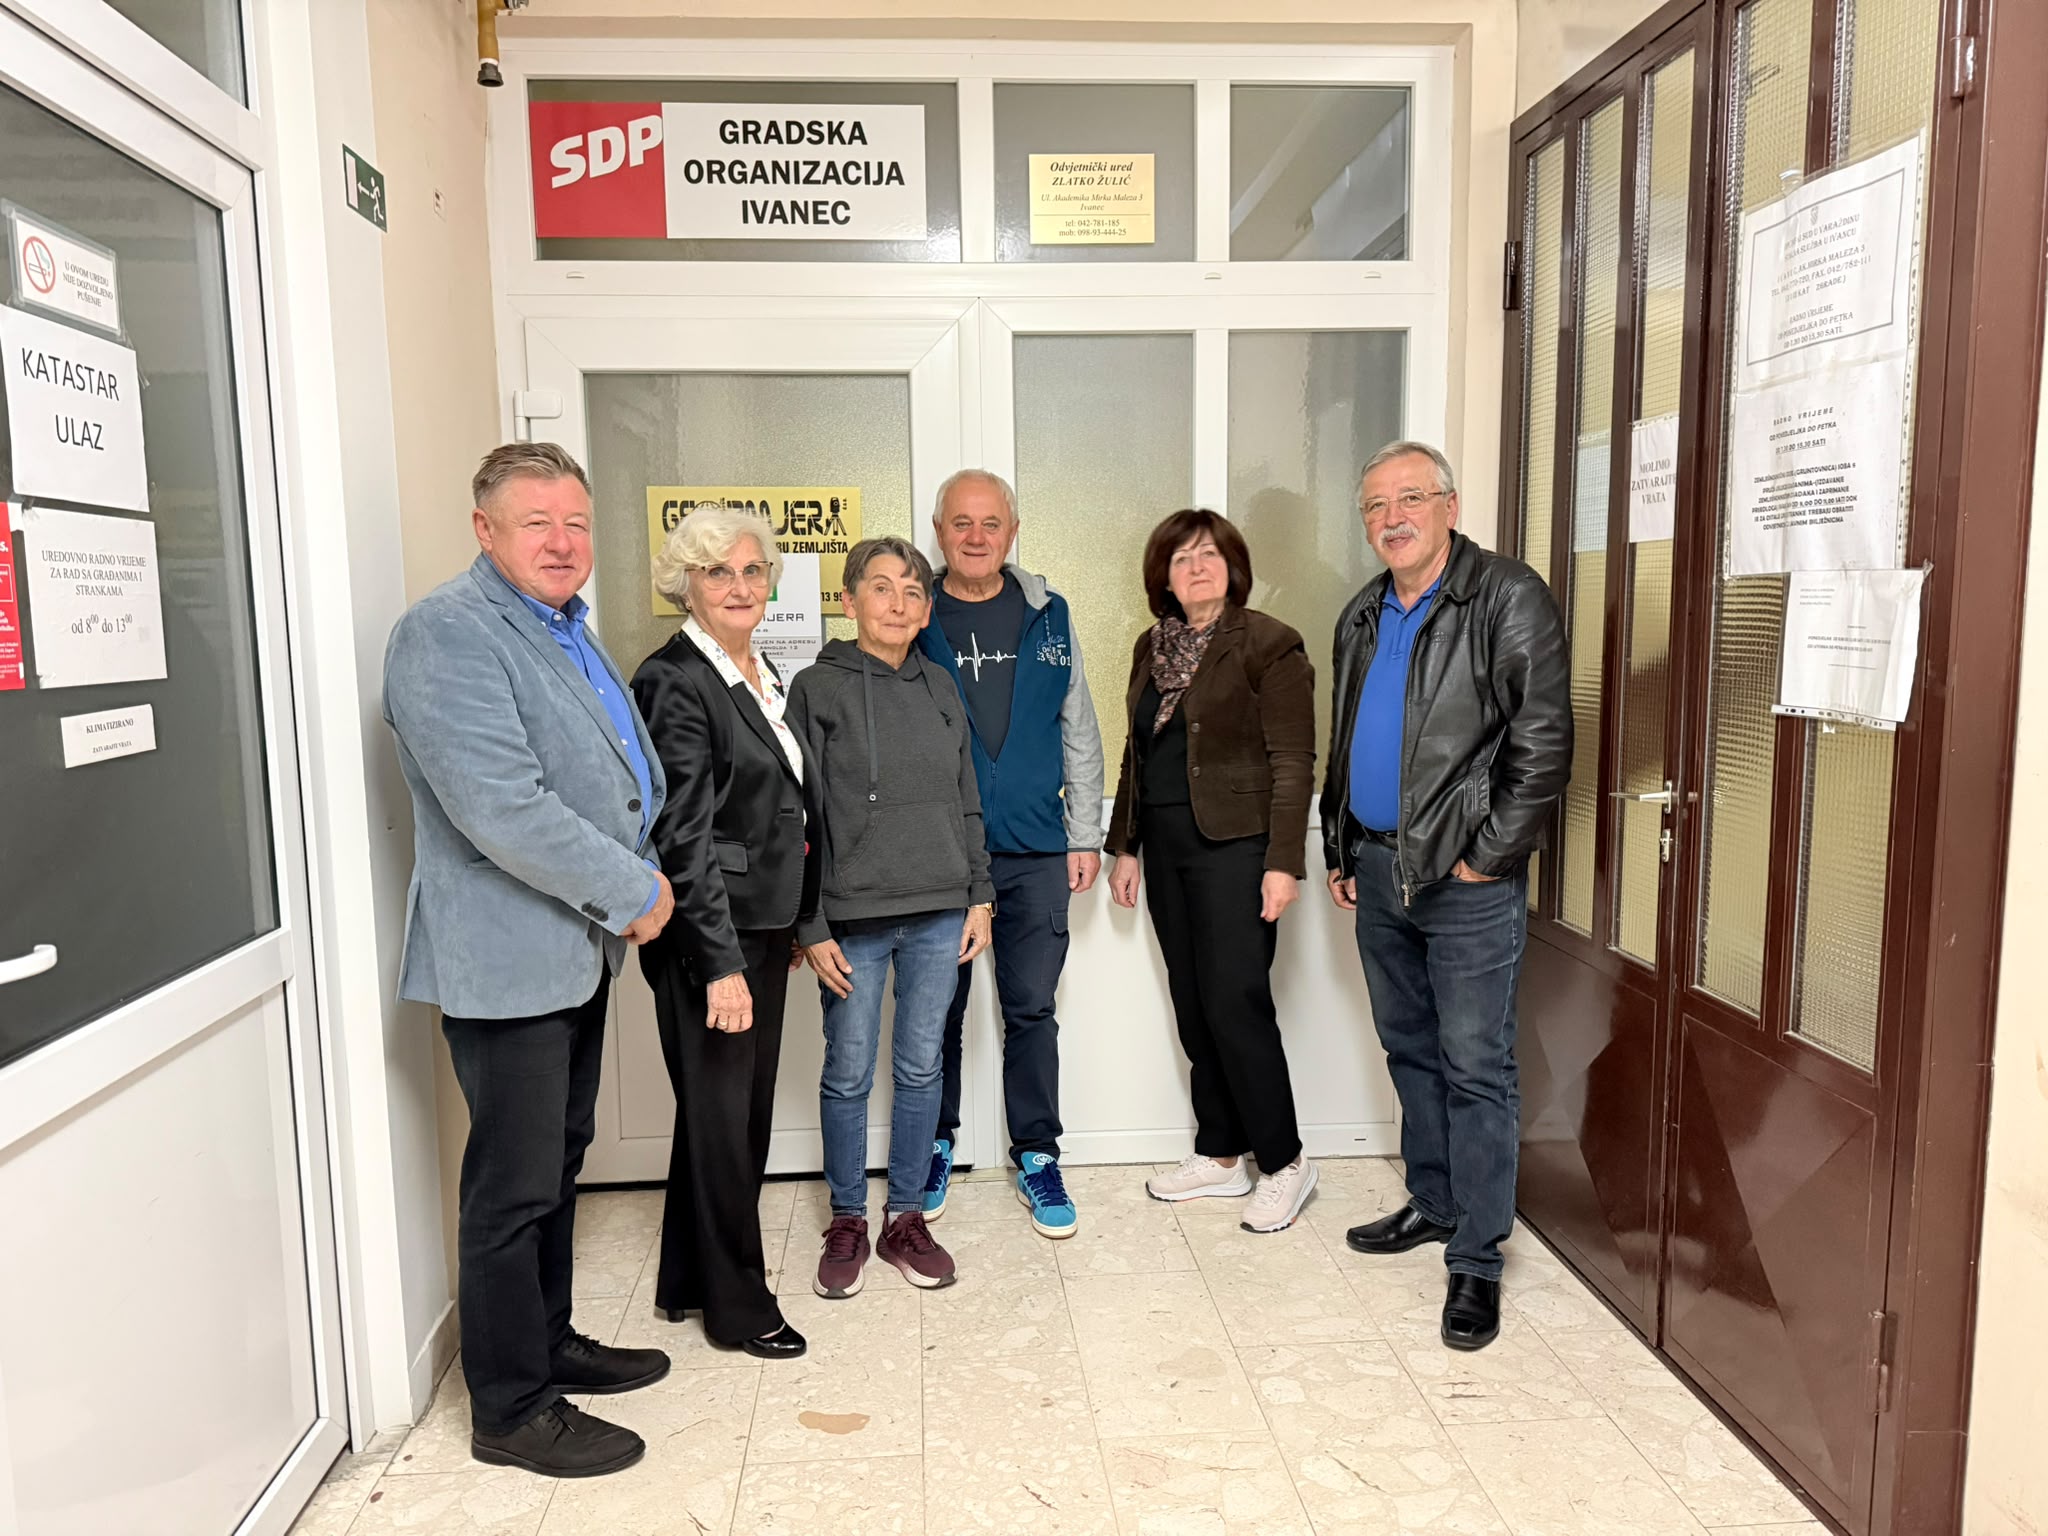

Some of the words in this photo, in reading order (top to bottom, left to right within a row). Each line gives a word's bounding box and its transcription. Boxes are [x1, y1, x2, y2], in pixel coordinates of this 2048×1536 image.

[719, 119, 868, 146] GRADSKA
[550, 114, 663, 189] SDP
[683, 160, 905, 187] ORGANIZACIJA
[1050, 161, 1108, 174] Odvjetnički
[1110, 161, 1134, 172] ured
[1052, 177, 1095, 186] ZLATKO
[1097, 173, 1132, 186] ŽULIĆ
[741, 200, 852, 226] IVANEC
[1080, 203, 1105, 211] Ivanec
[70, 263, 88, 278] OVOM
[89, 271, 109, 287] UREDU
[62, 271, 76, 285] NIJE
[76, 278, 113, 300] DOZVOLJENO
[1829, 311, 1854, 324] PETKA
[22, 347, 120, 401] KATASTAR
[1798, 406, 1834, 420] VRIJEME
[55, 414, 104, 451] ULAZ
[1817, 421, 1837, 431] PETKA
[1640, 458, 1670, 473] MOLIMO
[1632, 473, 1677, 491] ZATVARAJTE
[1642, 492, 1666, 505] VRATA
[793, 539, 848, 554] ZEMLJIŠTA
[42, 550, 88, 564] UREDOVNO
[89, 553, 116, 566] RADNO
[116, 555, 147, 567] VRIJEME
[50, 567, 62, 579] ZA
[63, 568, 81, 579] RAD
[82, 569, 92, 580] SA
[93, 569, 139, 582] GRAĐANIMA
[139, 571, 143, 582] I
[75, 585, 124, 597] STRANKAMA
[71, 618, 84, 634] od
[101, 618, 114, 633] do
[86, 718, 134, 734] KLIMATIZIRANO
